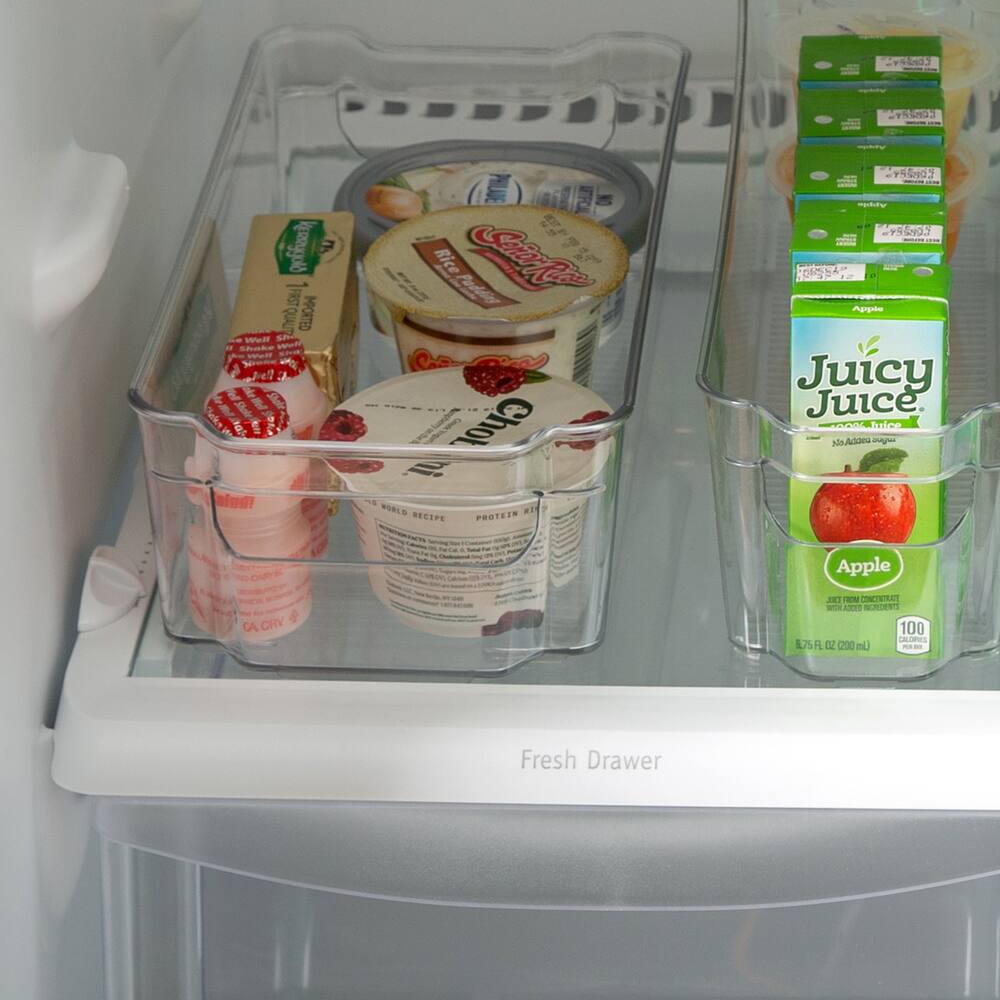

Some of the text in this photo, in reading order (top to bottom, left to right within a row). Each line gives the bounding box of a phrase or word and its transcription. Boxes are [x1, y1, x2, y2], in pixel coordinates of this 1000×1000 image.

[286, 221, 318, 272] Kerrygold
[434, 249, 453, 272] Rice
[456, 273, 500, 303] Pudding
[282, 308, 298, 335] QUALIT
[298, 296, 317, 331] IMPORTED
[797, 354, 933, 394] Juicy
[806, 389, 918, 418] Juice
[870, 421, 901, 429] Juice
[832, 439, 844, 447] No
[845, 437, 870, 446] Added
[382, 504, 407, 516] WORLD
[413, 511, 445, 521] RECIPE
[476, 511, 518, 521] PROTEIN
[837, 557, 890, 576] Apple
[844, 604, 862, 612] ADDED
[861, 595, 900, 603] CONCENTRATE
[901, 621, 924, 635] 100
[826, 640, 836, 649] OZ
[521, 749, 662, 770] Fresh Drawer
